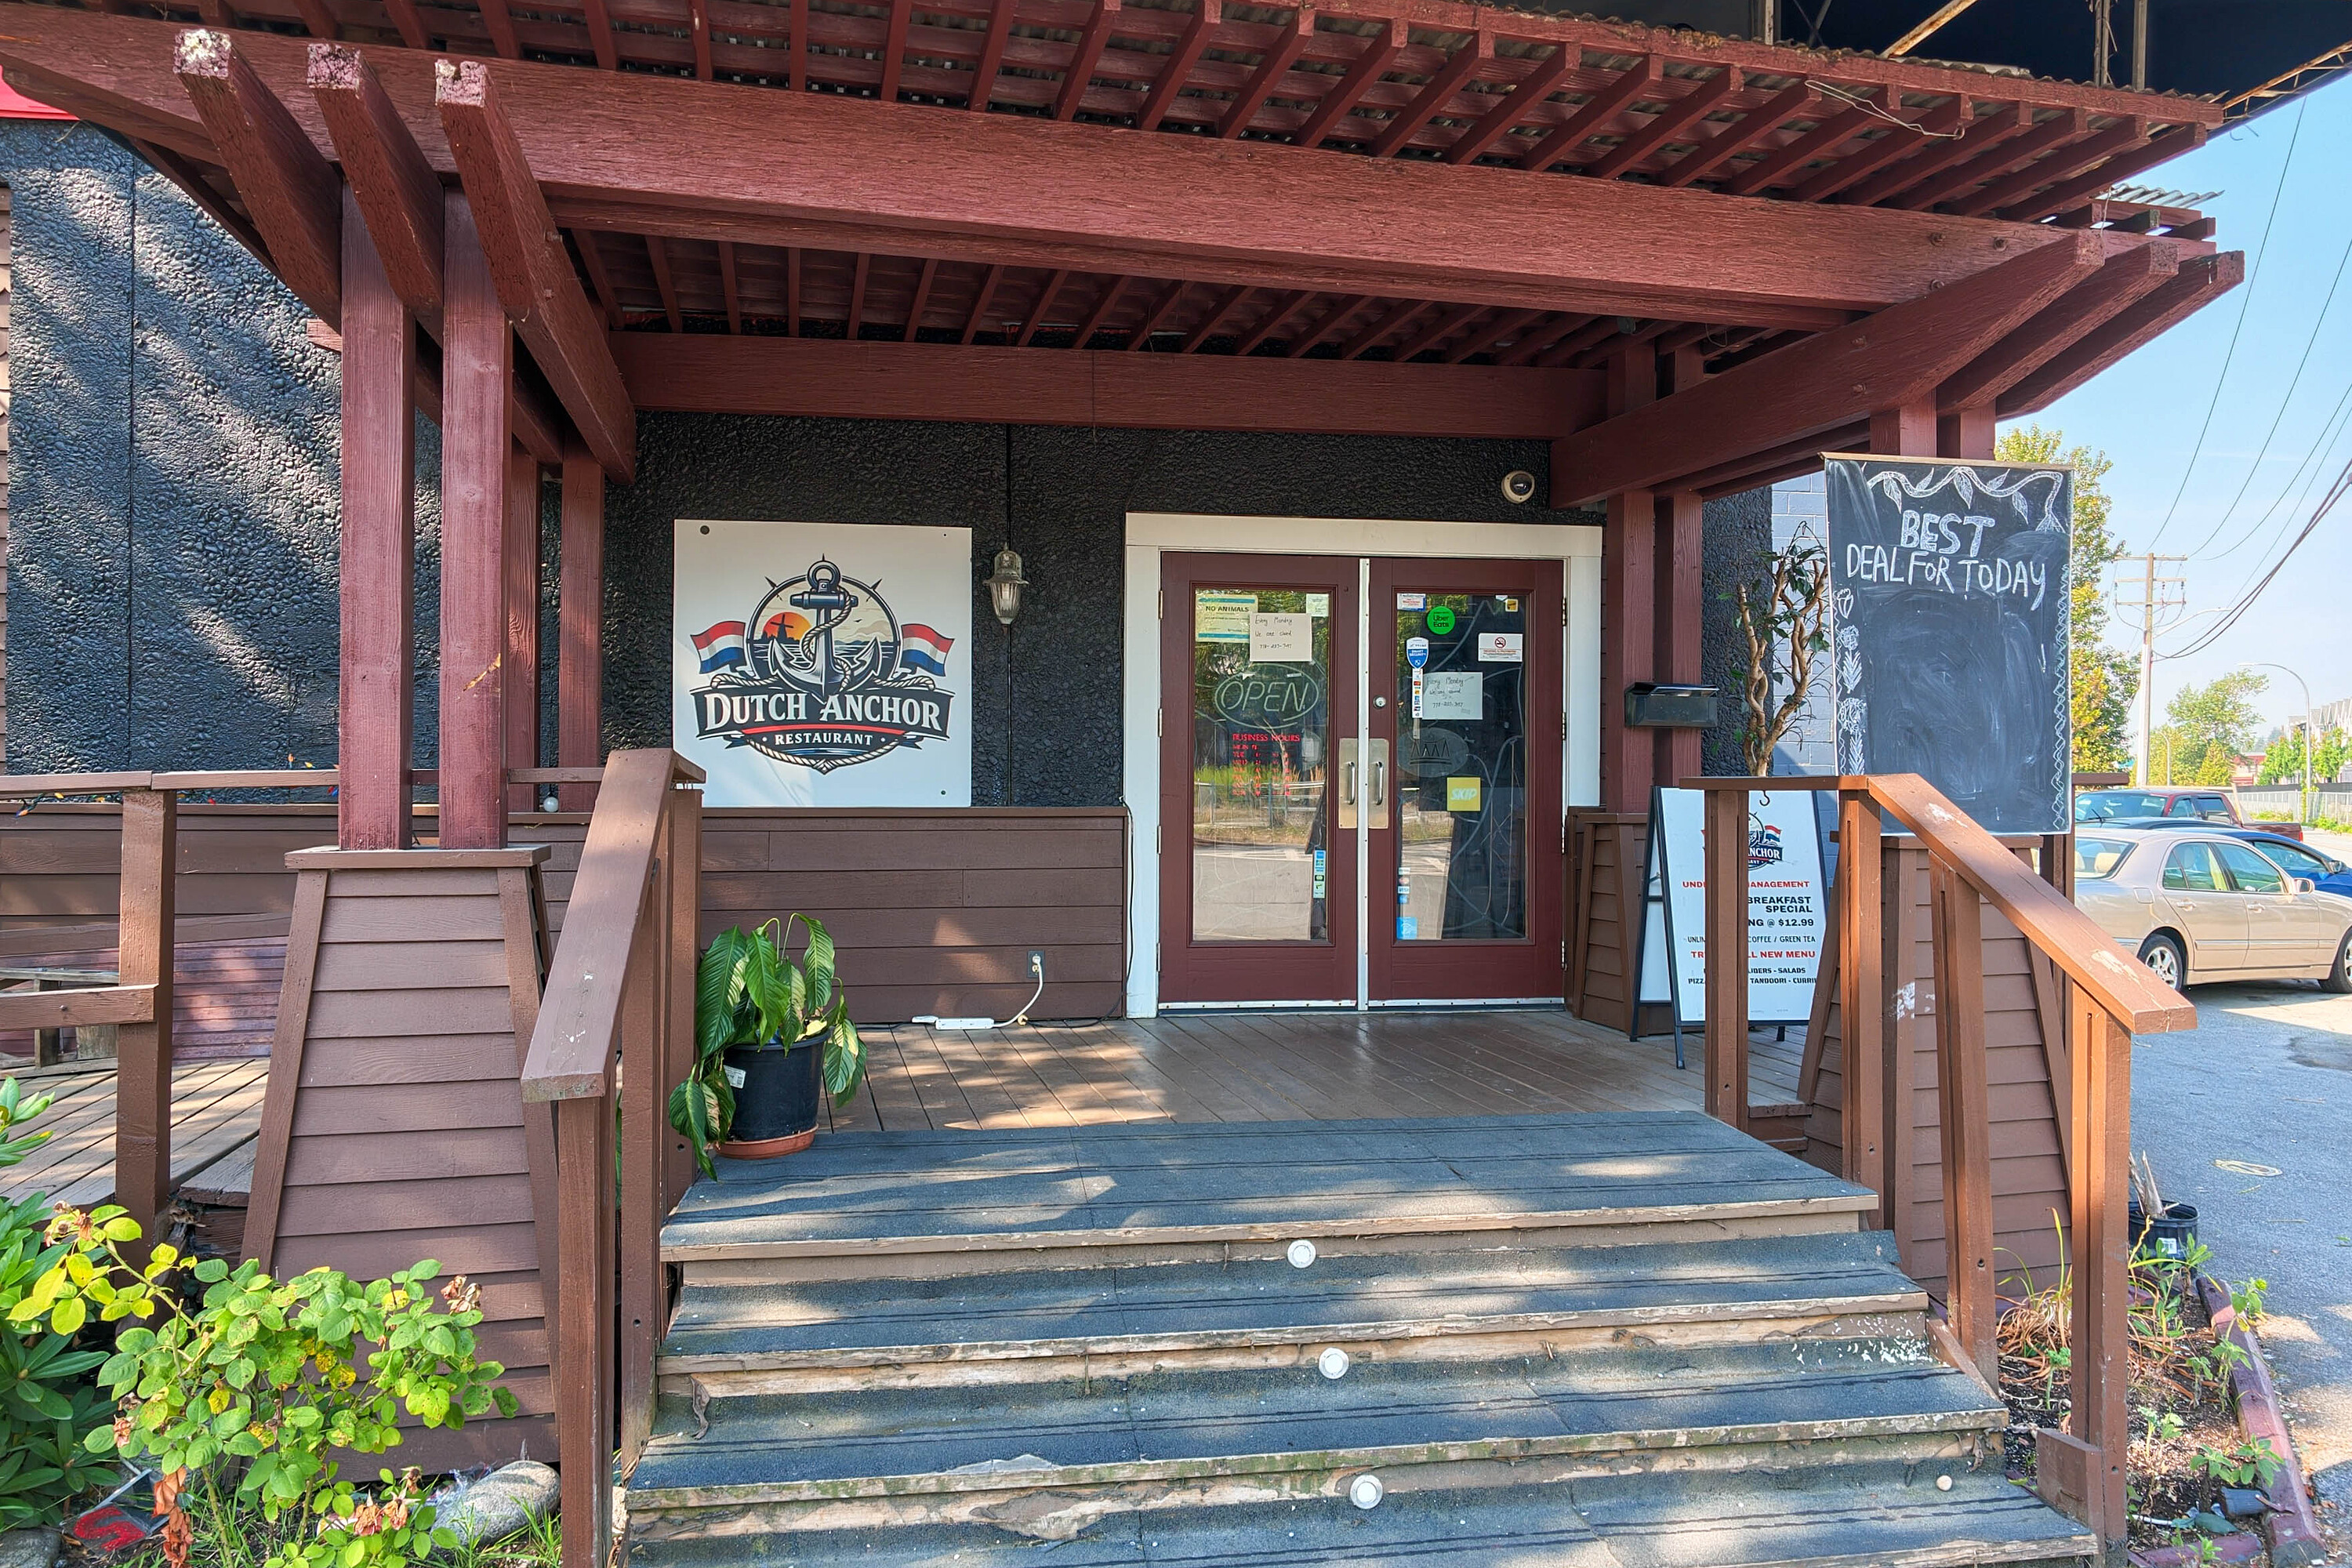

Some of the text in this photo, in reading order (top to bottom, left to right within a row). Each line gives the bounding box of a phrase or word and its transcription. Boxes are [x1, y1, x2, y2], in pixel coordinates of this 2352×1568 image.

[1900, 510, 1995, 557] BEST
[1846, 543, 2045, 611] DEAL FOR TODAY
[704, 693, 942, 731] DUTCH ANCHOR
[1221, 681, 1308, 712] OPEN
[775, 732, 873, 745] RESTAURANT
[1748, 848, 1780, 859] NCHOR
[1778, 918, 1814, 927] $12.99
